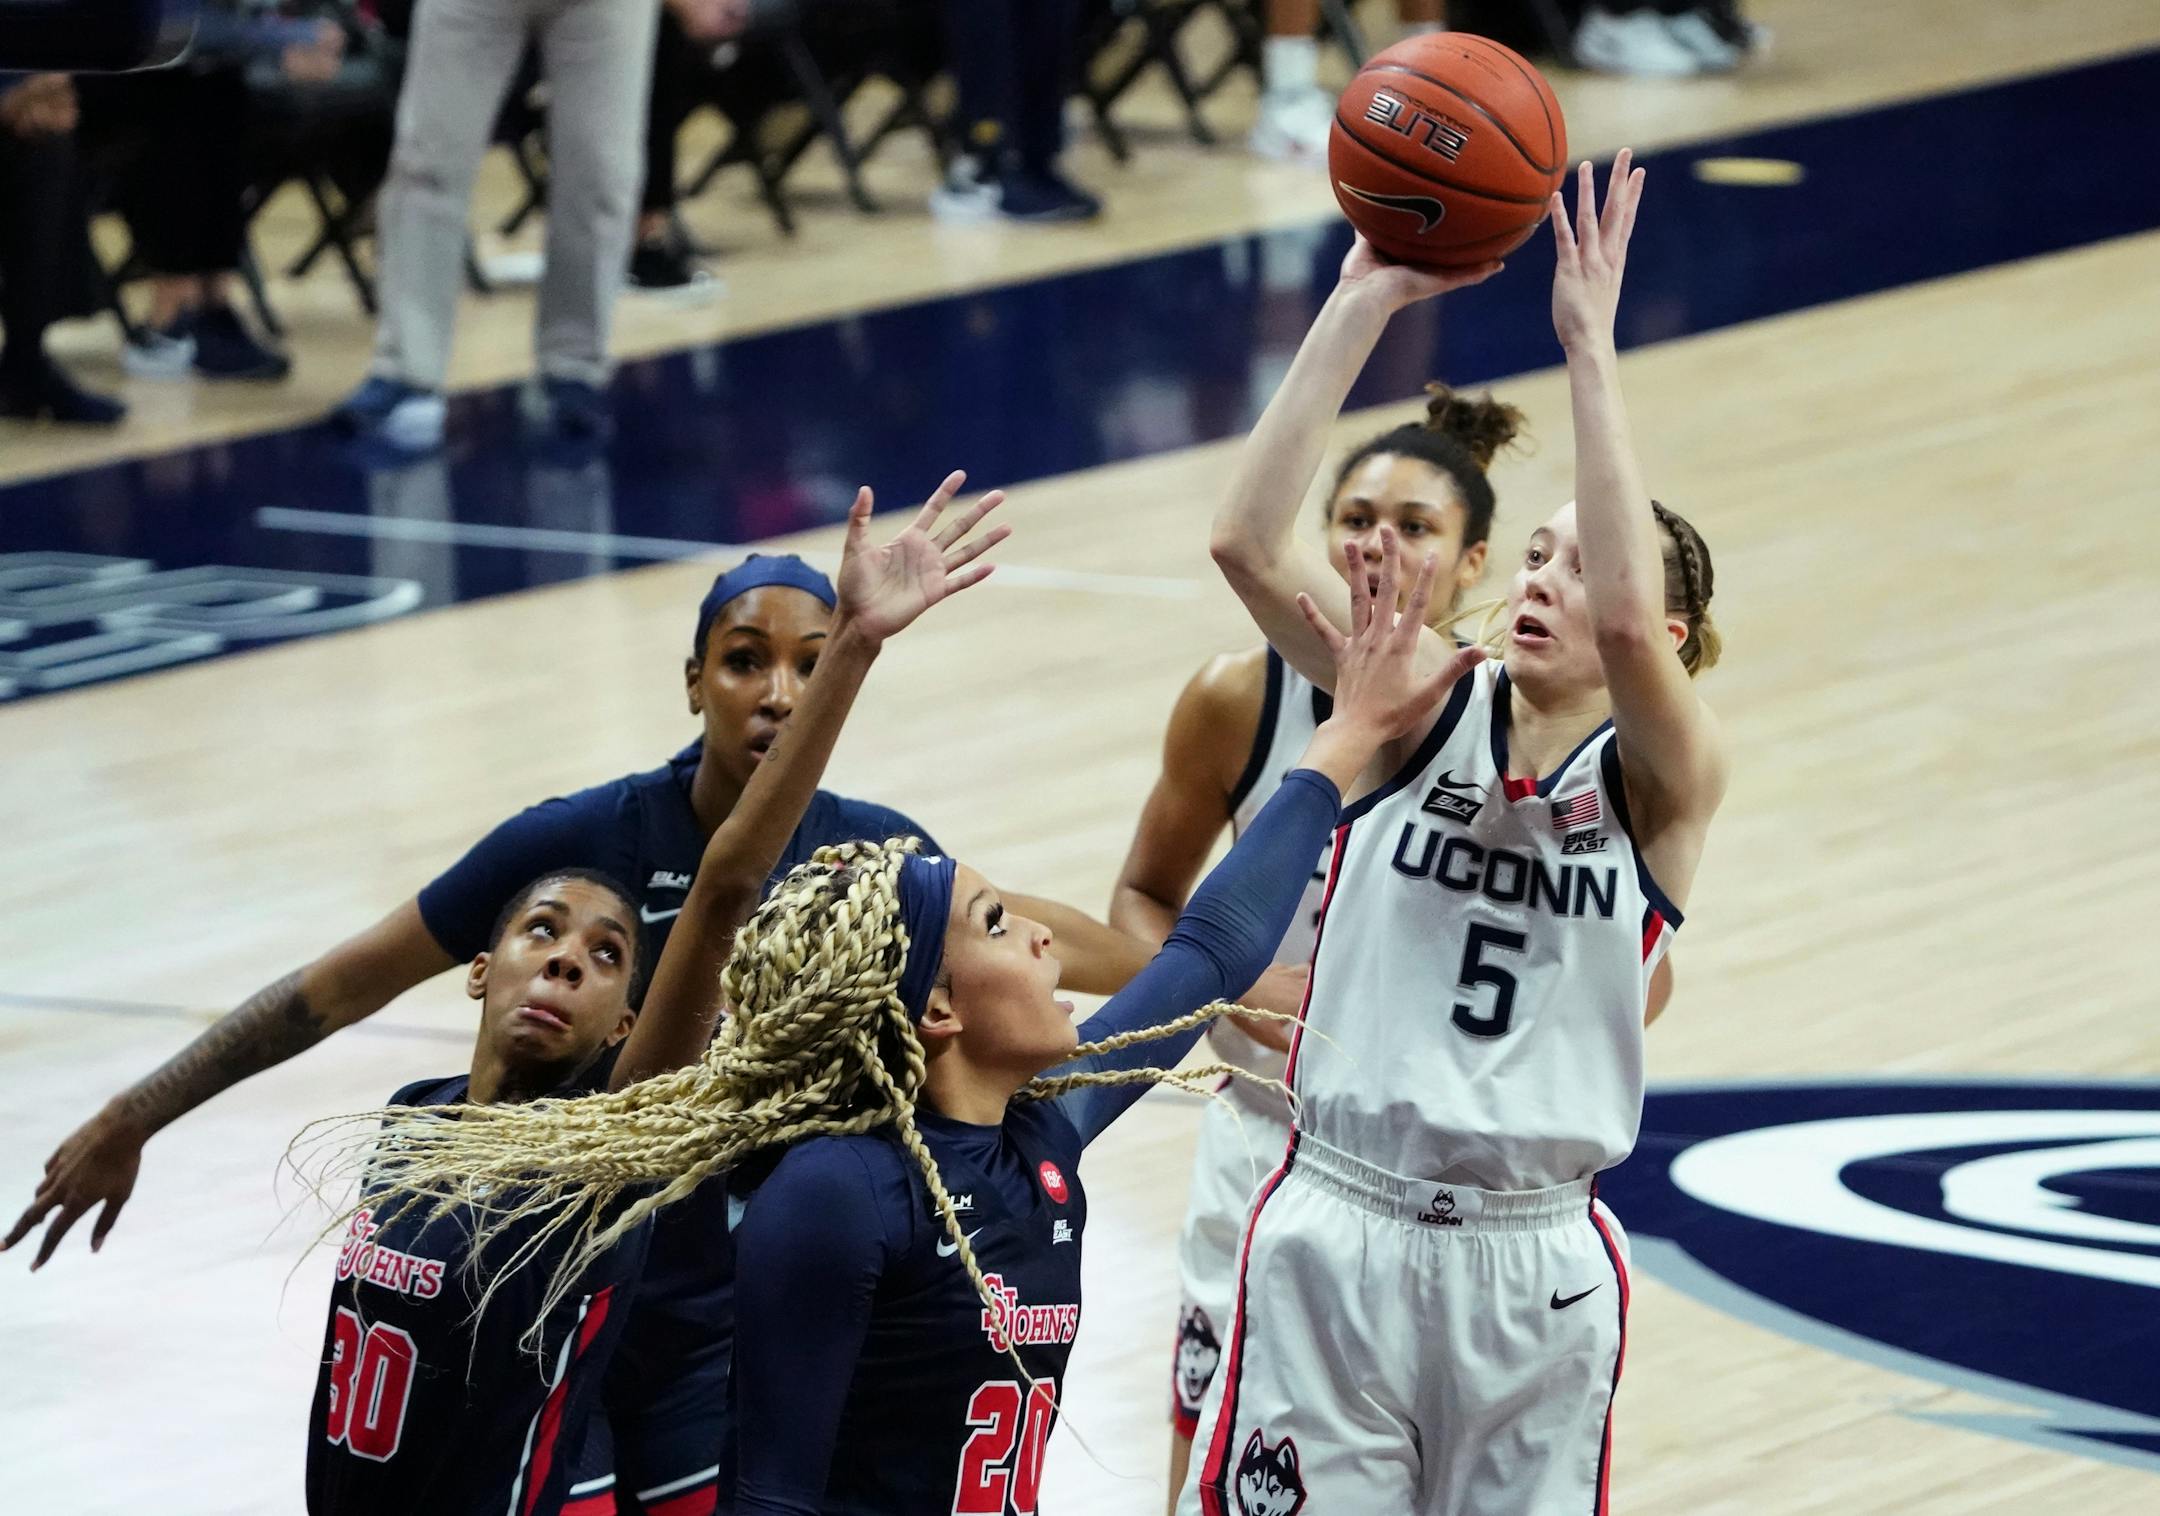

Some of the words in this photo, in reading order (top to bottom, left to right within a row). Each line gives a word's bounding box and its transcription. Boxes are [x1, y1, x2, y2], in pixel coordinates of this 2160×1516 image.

[1364, 91, 1469, 165] ELITE
[1431, 794, 1478, 814] BLM
[1561, 837, 1609, 853] EAST
[1563, 828, 1598, 845] BIG
[1391, 821, 1618, 920] UCONN
[1450, 919, 1529, 1039] 5
[1053, 1228, 1073, 1240] EAST
[1417, 1211, 1463, 1226] UCONN
[336, 1240, 447, 1299] JOHN'S
[988, 1303, 1079, 1353] JOHN'S
[326, 1305, 419, 1463] 30
[951, 1377, 1056, 1516] 20
